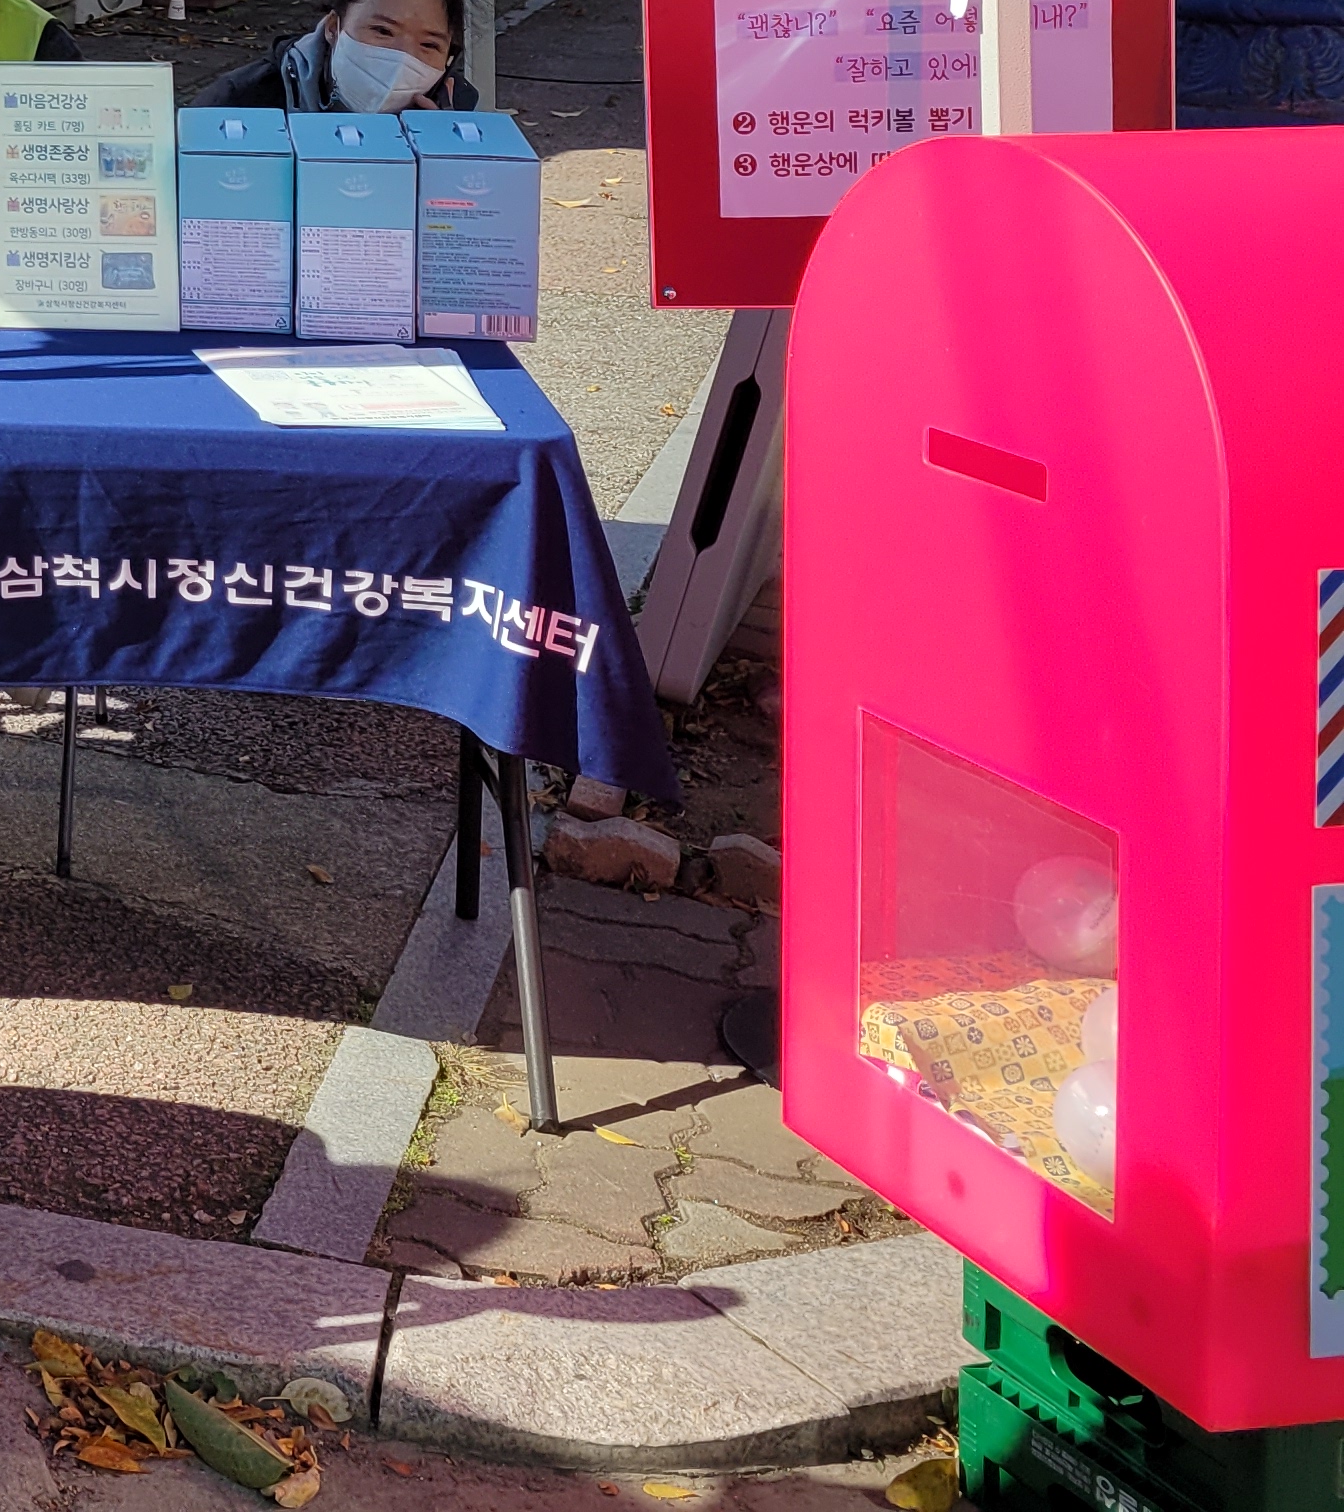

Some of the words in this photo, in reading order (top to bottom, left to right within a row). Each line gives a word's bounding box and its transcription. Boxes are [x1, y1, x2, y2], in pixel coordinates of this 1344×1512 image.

[19, 93, 88, 110] 마음건강상
[13, 120, 33, 132] 폴딩
[37, 120, 57, 132] 카트
[768, 109, 834, 136] 행운의
[848, 107, 916, 134] 럭키볼
[927, 106, 973, 132] 뽑기
[21, 144, 90, 162] 생명존중상
[769, 150, 858, 178] 행운상에
[61, 172, 91, 185] (33명)
[21, 197, 90, 215] 생명사랑상
[62, 226, 92, 239] (30명)
[22, 251, 91, 269] 생명지킴상
[15, 279, 54, 292] 장바구니
[58, 279, 88, 293] (30명)
